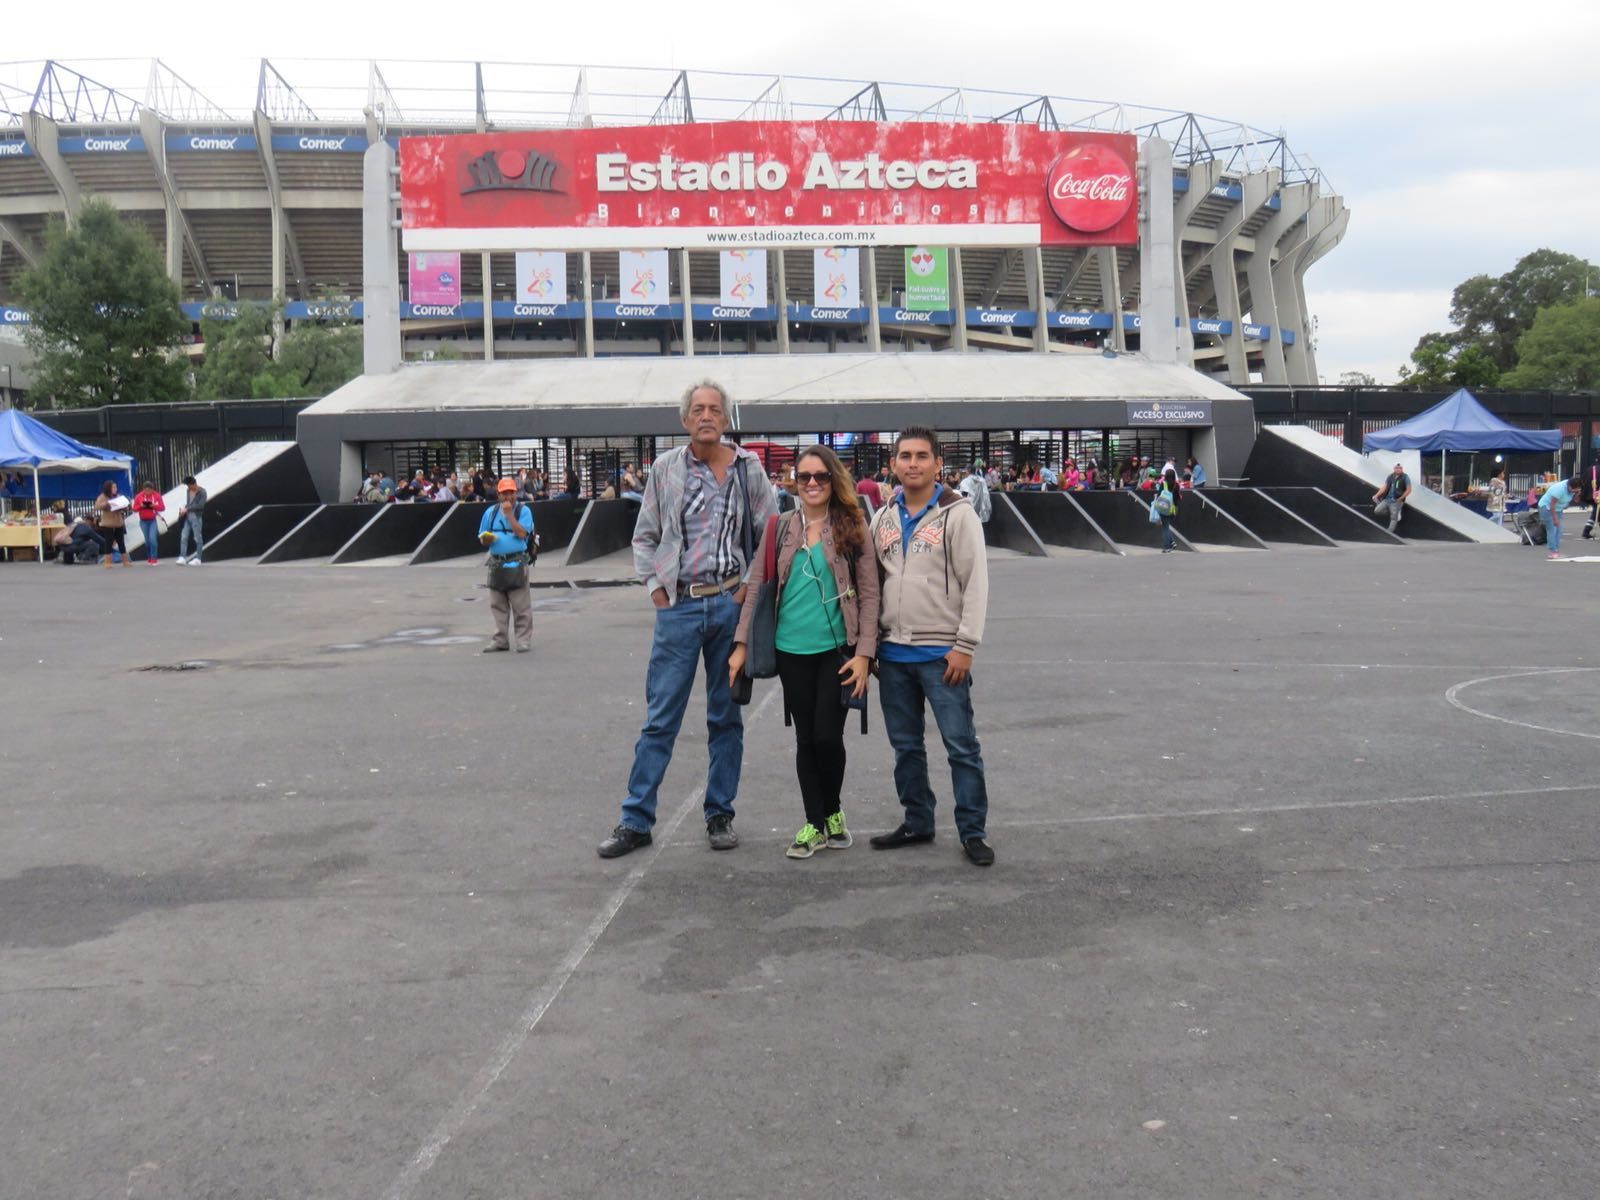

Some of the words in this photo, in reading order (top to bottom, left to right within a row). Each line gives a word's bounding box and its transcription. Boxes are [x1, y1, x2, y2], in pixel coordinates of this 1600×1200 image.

[0, 141, 25, 155] mex
[85, 138, 131, 151] Comex
[190, 136, 238, 150] Comex
[299, 136, 346, 150] Comex
[596, 151, 788, 193] Estadio
[803, 151, 978, 191] Azteca
[1053, 173, 1131, 201] Coca-Cola
[1212, 186, 1229, 197] mex
[597, 201, 978, 219] Bienvenidos
[706, 230, 876, 243] www.estadioazteca.com.mx
[4, 310, 31, 322] Com
[413, 304, 457, 316] Comex
[513, 304, 558, 316] Comex
[615, 304, 659, 317] Comex
[712, 306, 753, 318] Comex
[810, 308, 850, 320] Comex
[895, 310, 933, 321] Comex
[980, 312, 1017, 324] Comex
[1058, 315, 1093, 326] Comex
[1197, 321, 1222, 333] Comex
[1243, 325, 1263, 336] Comex
[1132, 410, 1163, 420] ACCESO
[1164, 410, 1205, 420] EXCLUSIVO
